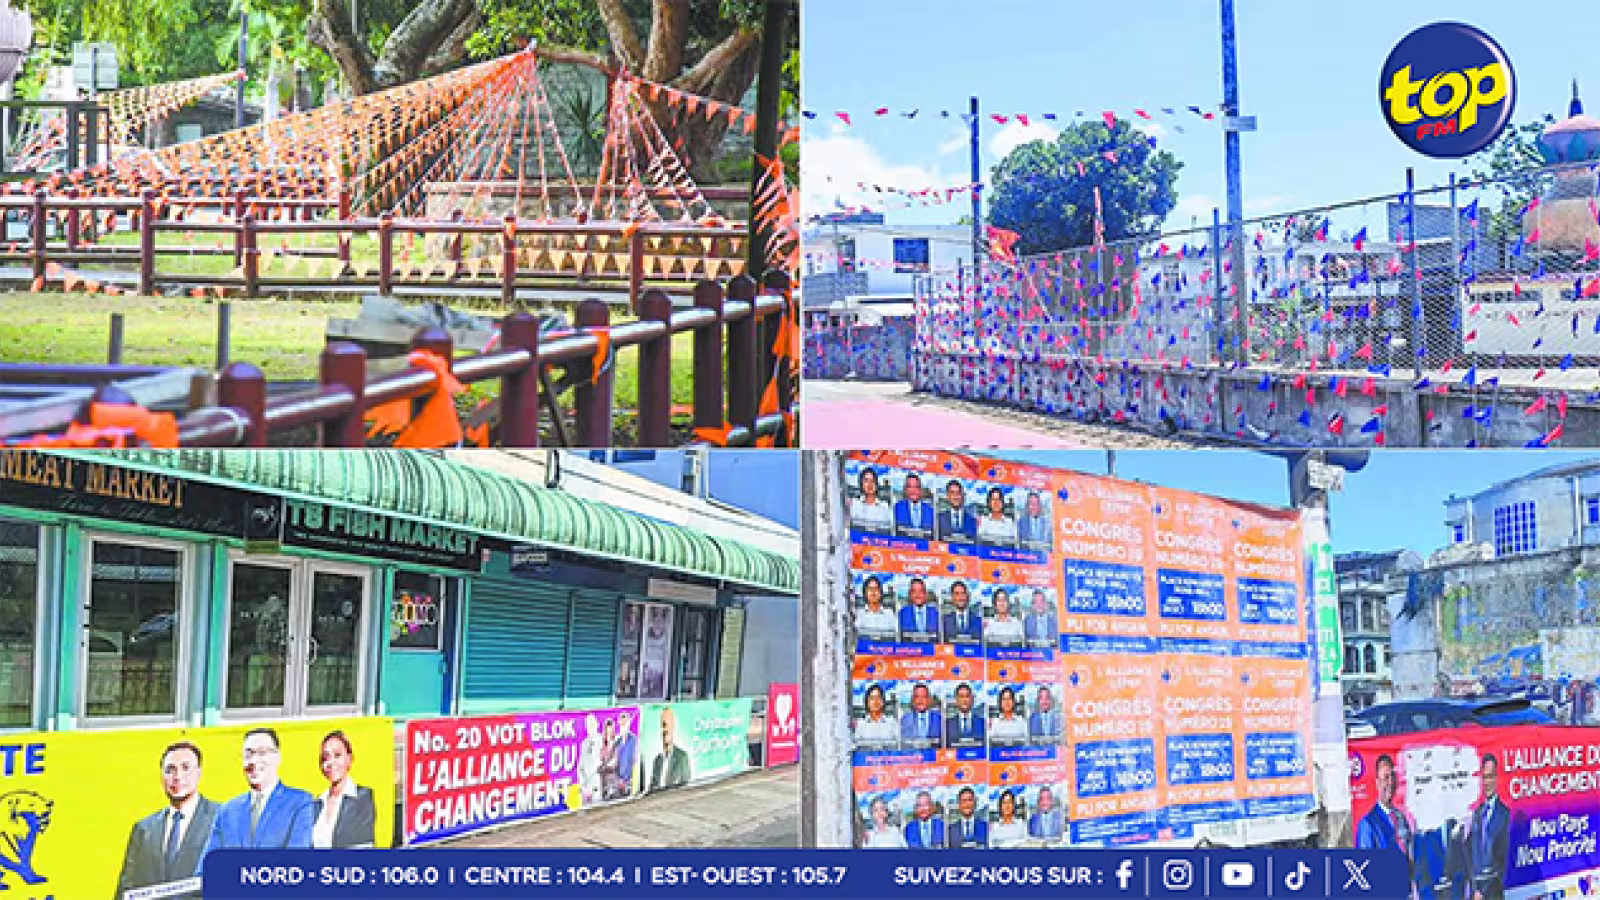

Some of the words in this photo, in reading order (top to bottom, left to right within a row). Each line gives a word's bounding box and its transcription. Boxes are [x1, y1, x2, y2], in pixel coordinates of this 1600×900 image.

[0, 451, 74, 488] MEAT
[86, 462, 186, 507] MARKET
[330, 506, 386, 540] FISH
[390, 517, 479, 555] MARKET
[414, 730, 450, 754] No.
[457, 727, 481, 748] 20
[486, 722, 526, 746] VOT
[530, 719, 576, 742] BLOK
[1503, 745, 1584, 772] L'ALLIANCE
[412, 747, 545, 796] L'ALLIANCE
[549, 745, 578, 774] DU
[414, 779, 571, 833] CHANGEMENT
